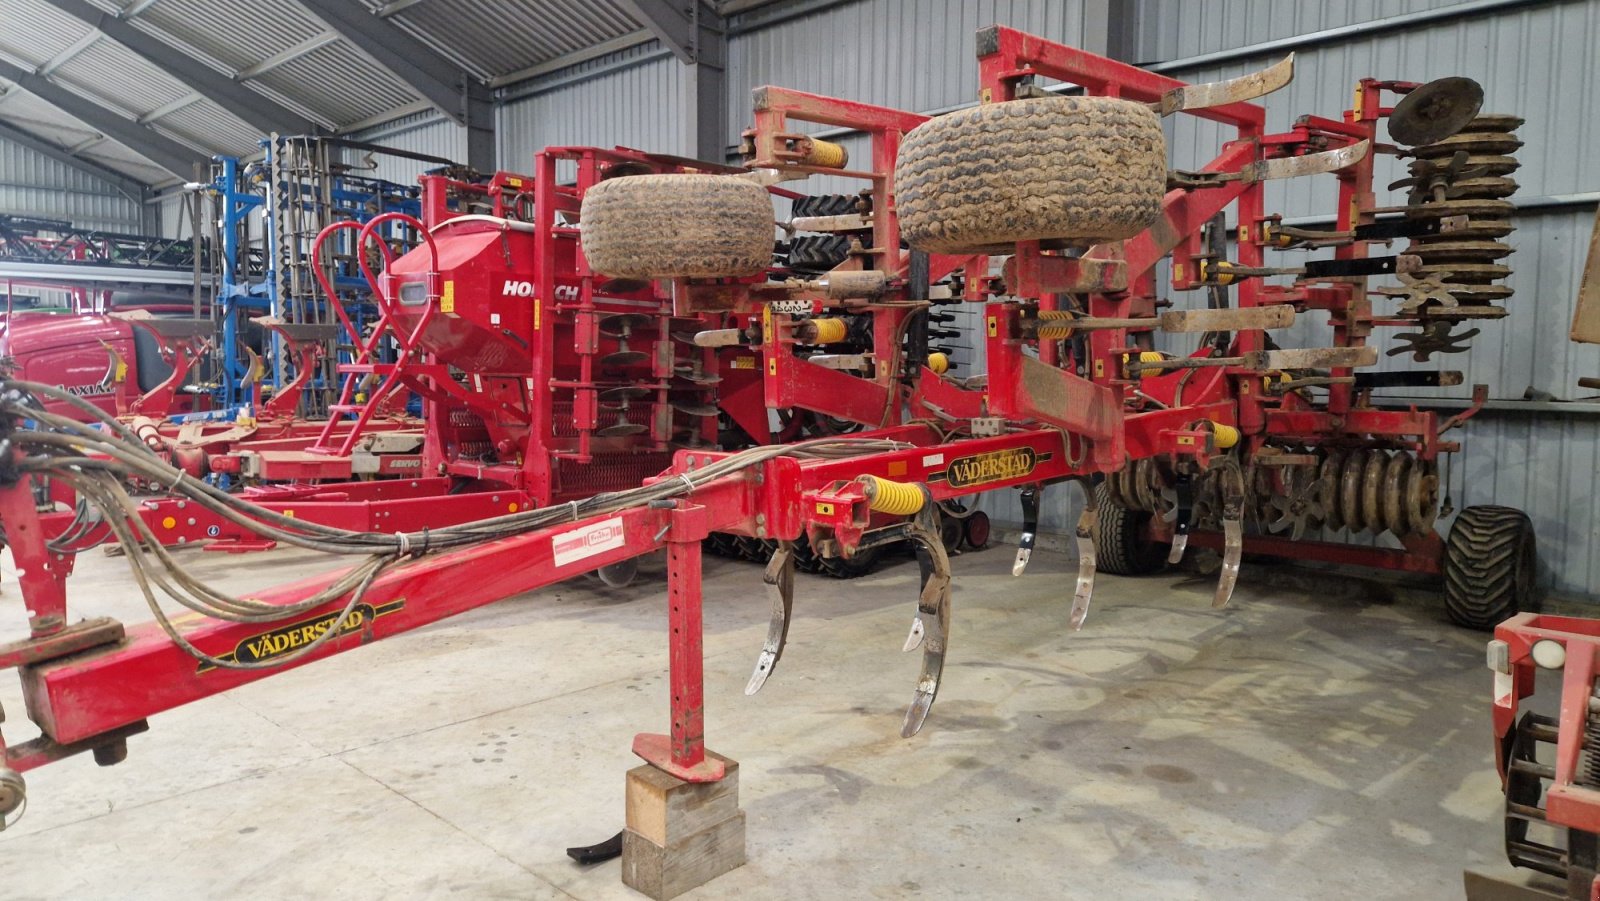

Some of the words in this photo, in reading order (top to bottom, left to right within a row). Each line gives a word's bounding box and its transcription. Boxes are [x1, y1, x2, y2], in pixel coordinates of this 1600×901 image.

[502, 280, 579, 301] HOCH
[390, 459, 421, 468] SERVO
[953, 453, 1030, 482] VÄDERSTAD
